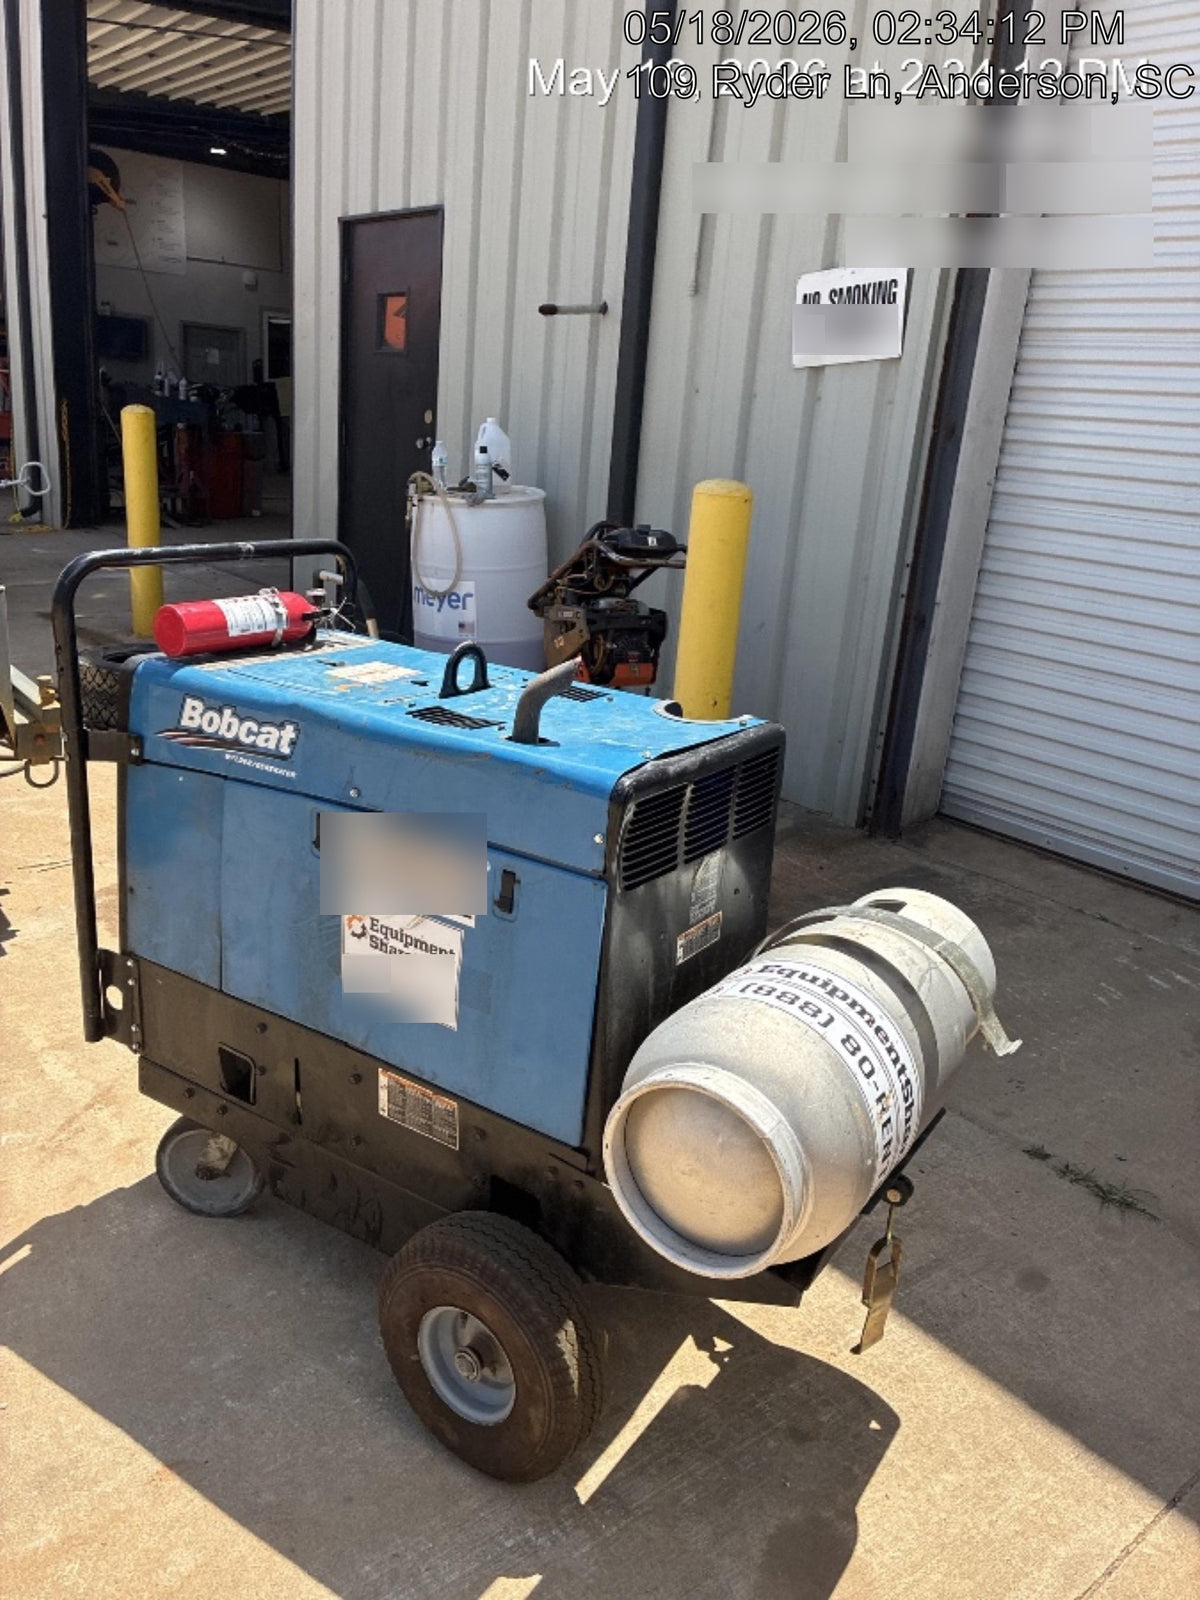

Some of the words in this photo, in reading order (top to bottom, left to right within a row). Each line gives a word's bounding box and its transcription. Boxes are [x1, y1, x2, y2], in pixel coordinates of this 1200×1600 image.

[414, 585, 474, 612] meyer
[179, 695, 298, 757] Bobcat
[739, 983, 835, 1028] (888)
